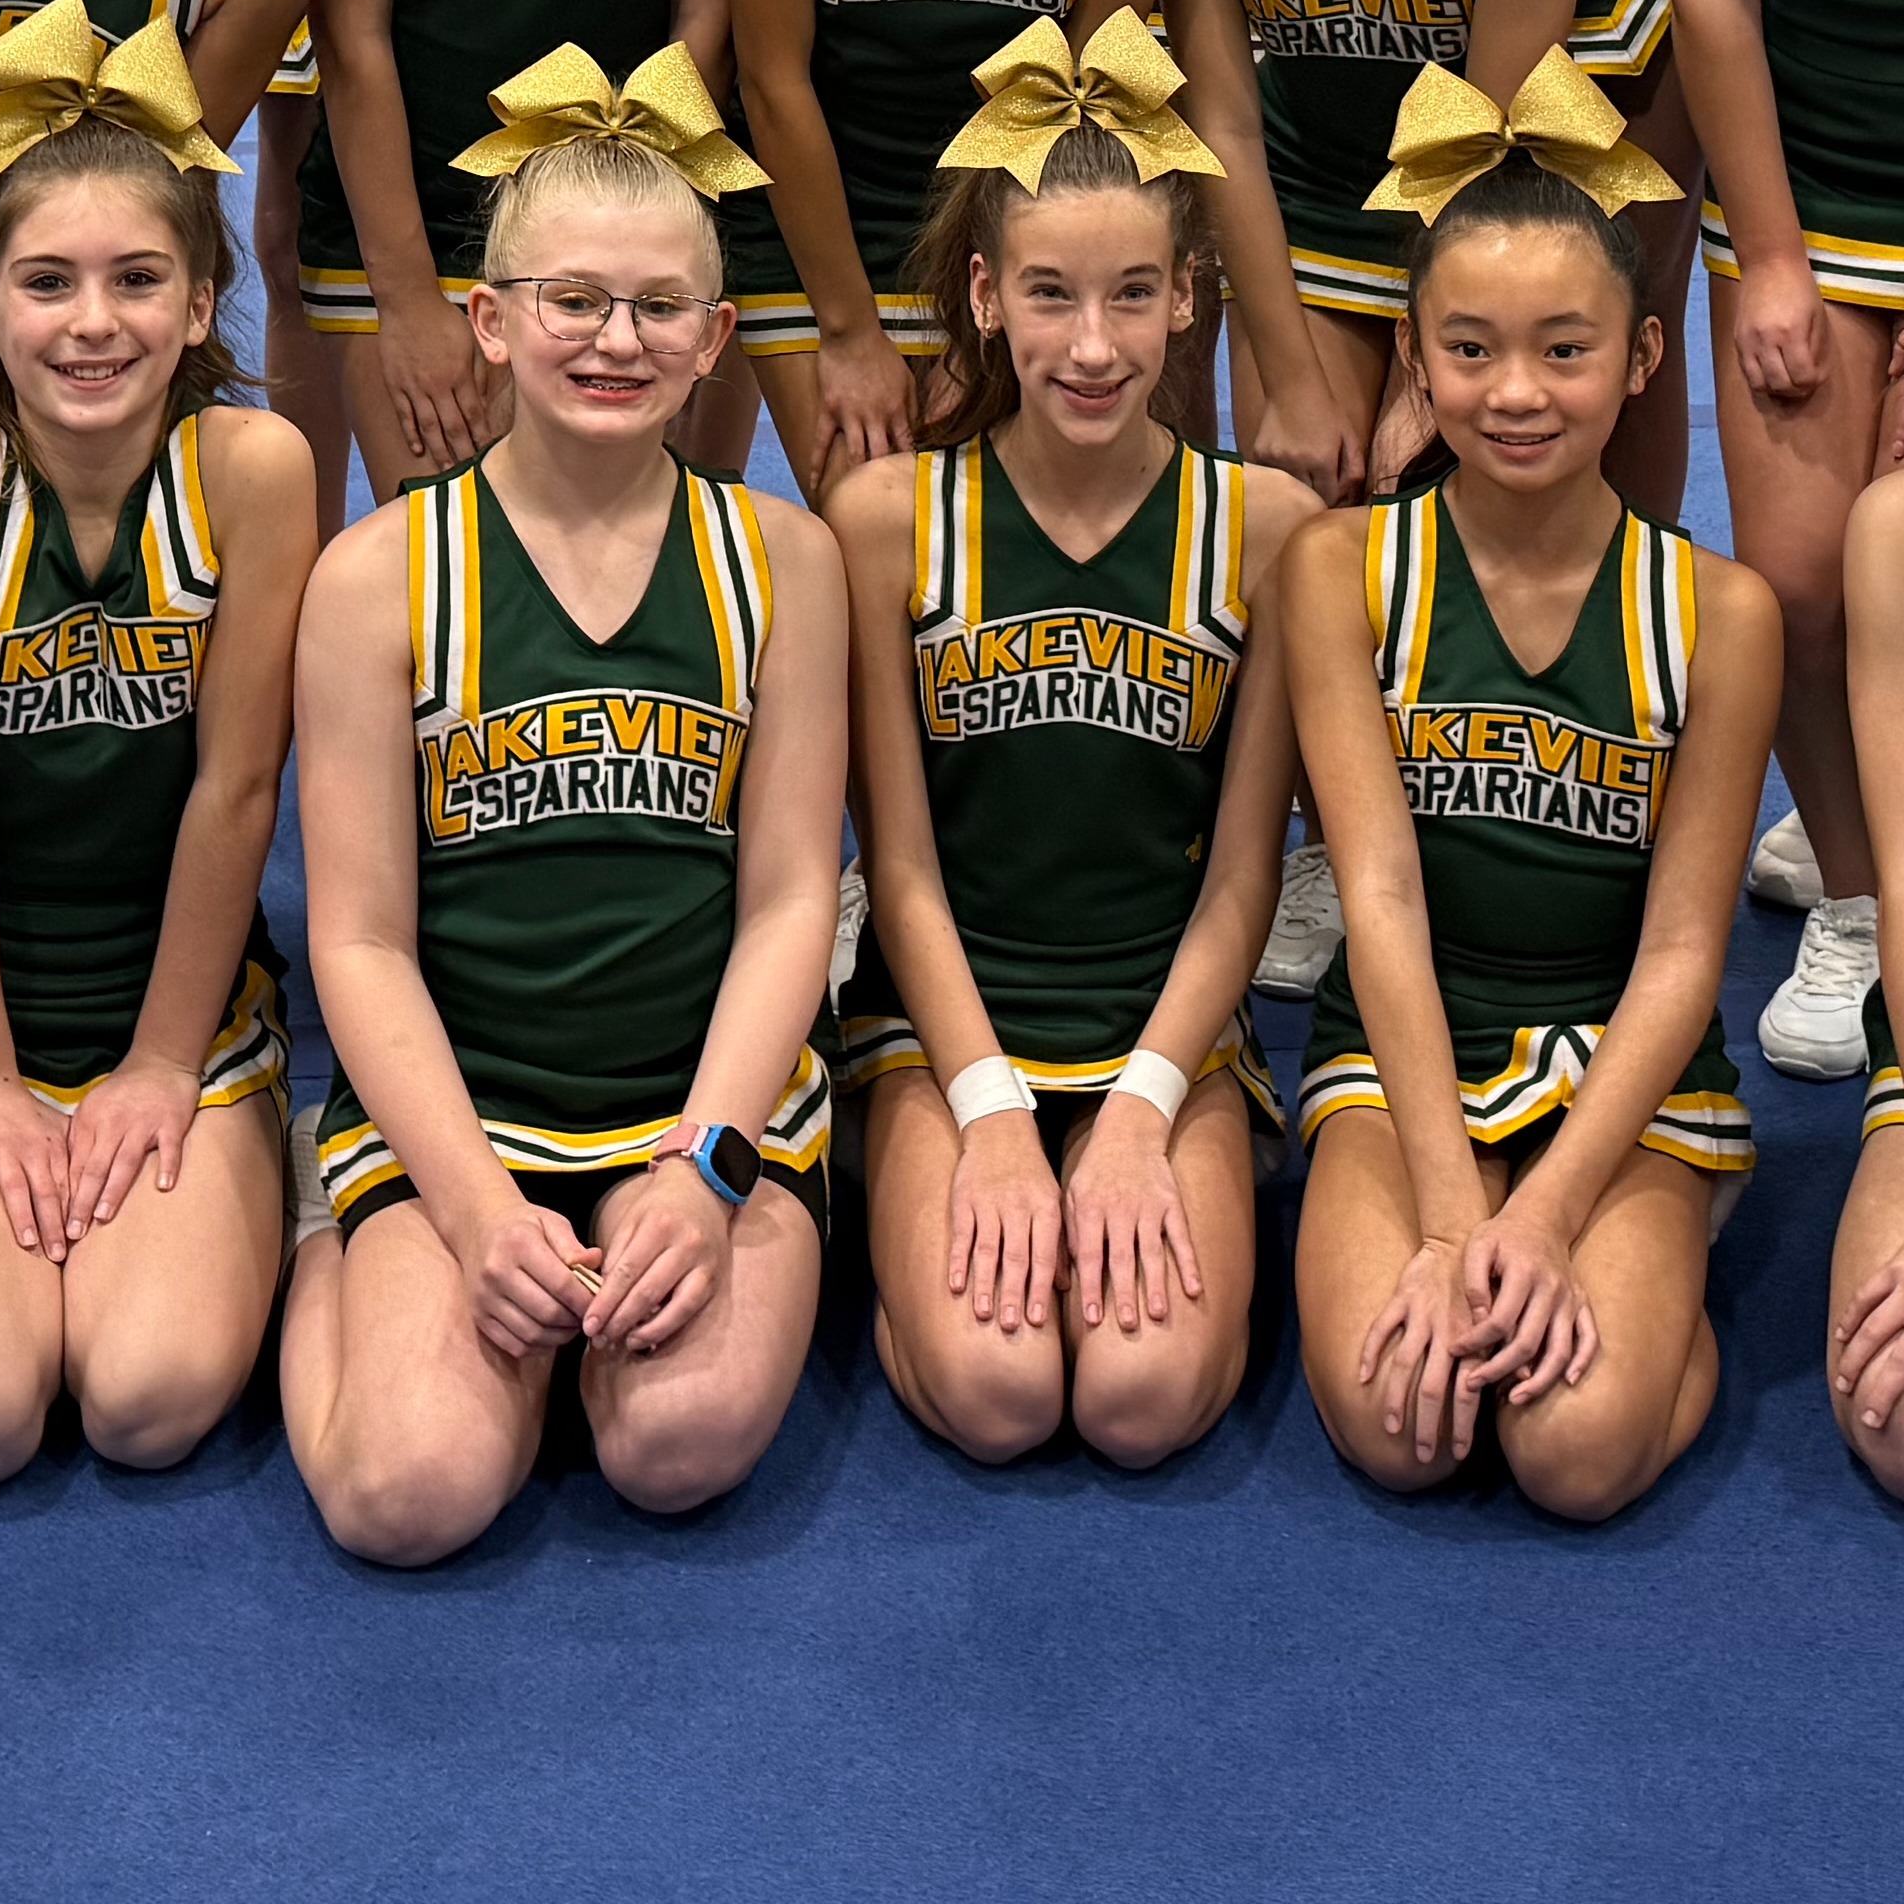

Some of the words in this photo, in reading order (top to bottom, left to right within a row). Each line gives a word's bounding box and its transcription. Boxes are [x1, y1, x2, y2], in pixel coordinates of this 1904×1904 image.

[1262, 16, 1467, 63] SPARTANS
[913, 607, 1240, 751] LAKEVIEW
[962, 669, 1186, 747] SPARTANS
[472, 757, 713, 831] SPARTANS
[1399, 764, 1644, 845] SPARTANS
